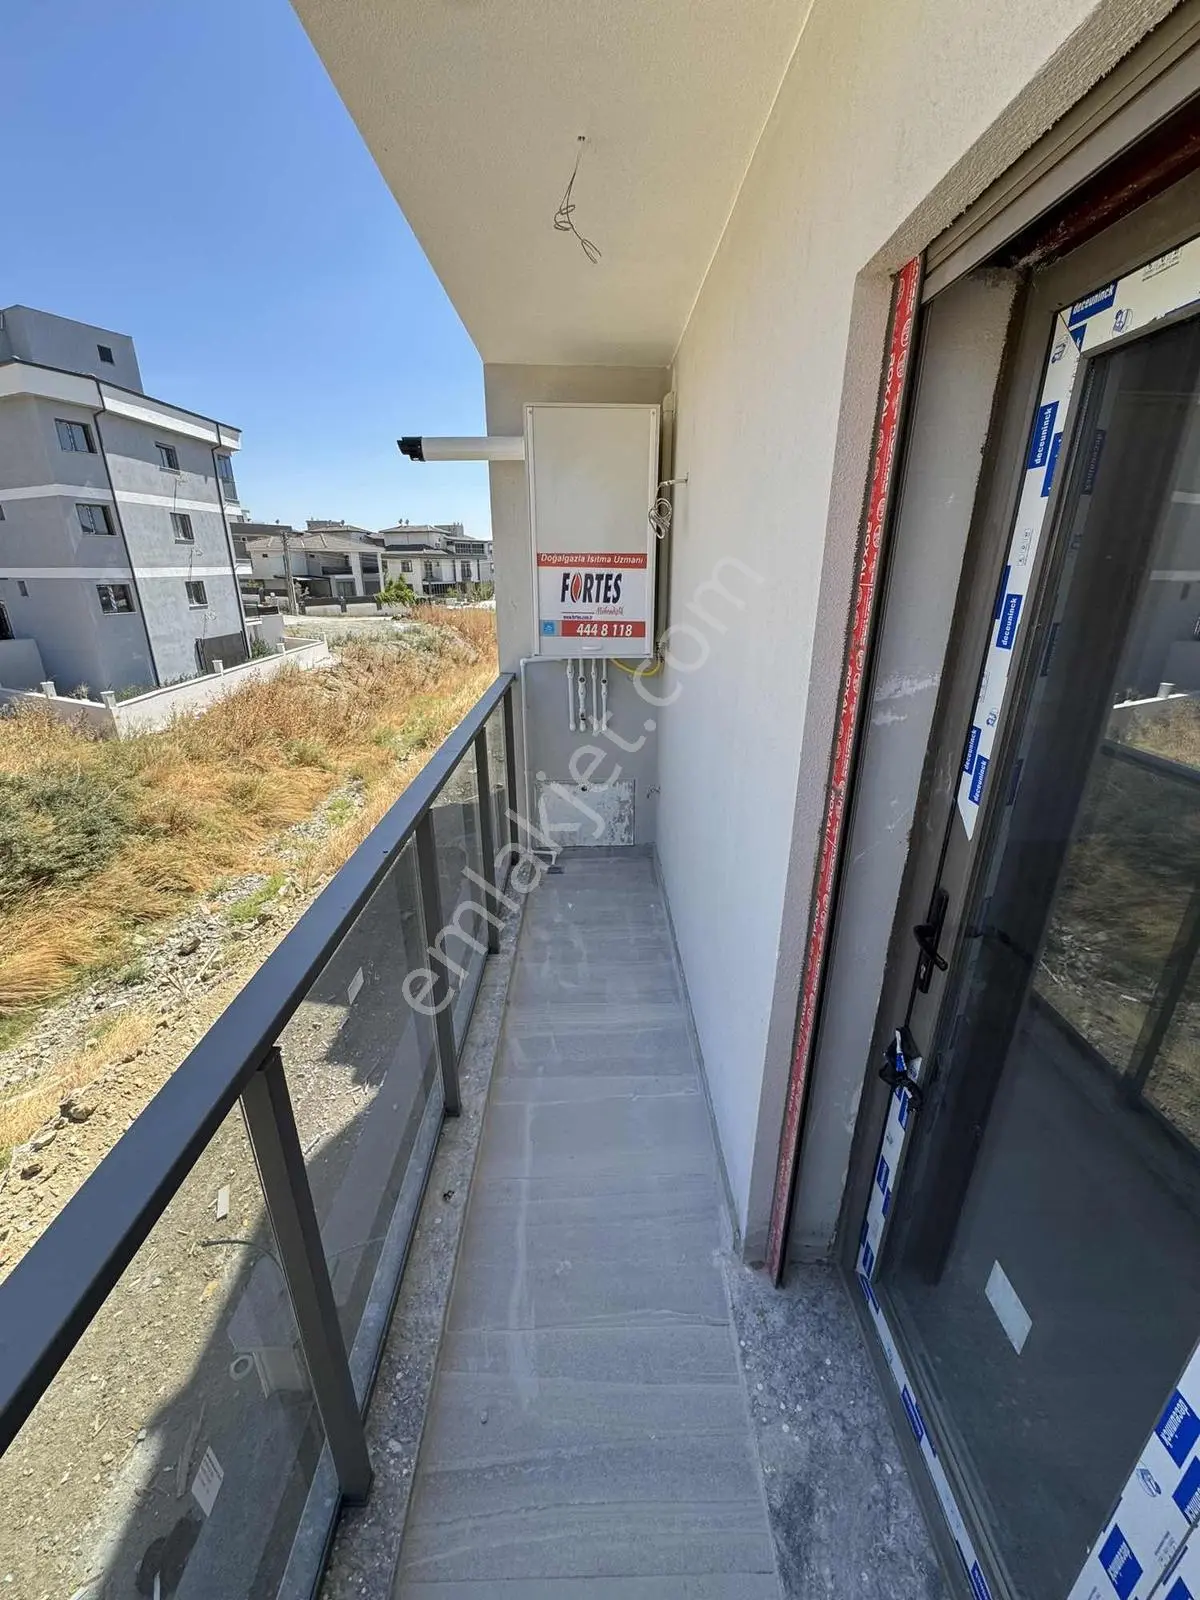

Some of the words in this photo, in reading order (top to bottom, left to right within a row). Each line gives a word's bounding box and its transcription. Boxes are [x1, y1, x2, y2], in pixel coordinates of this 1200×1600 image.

[1034, 407, 1052, 465] deceuninck
[561, 572, 623, 604] FORTES
[577, 623, 598, 636] 444
[601, 624, 608, 636] 8
[613, 624, 633, 637] 118
[1001, 597, 1017, 646] deceuninck
[963, 728, 977, 771] deceuninck
[972, 759, 987, 802] deceuninck
